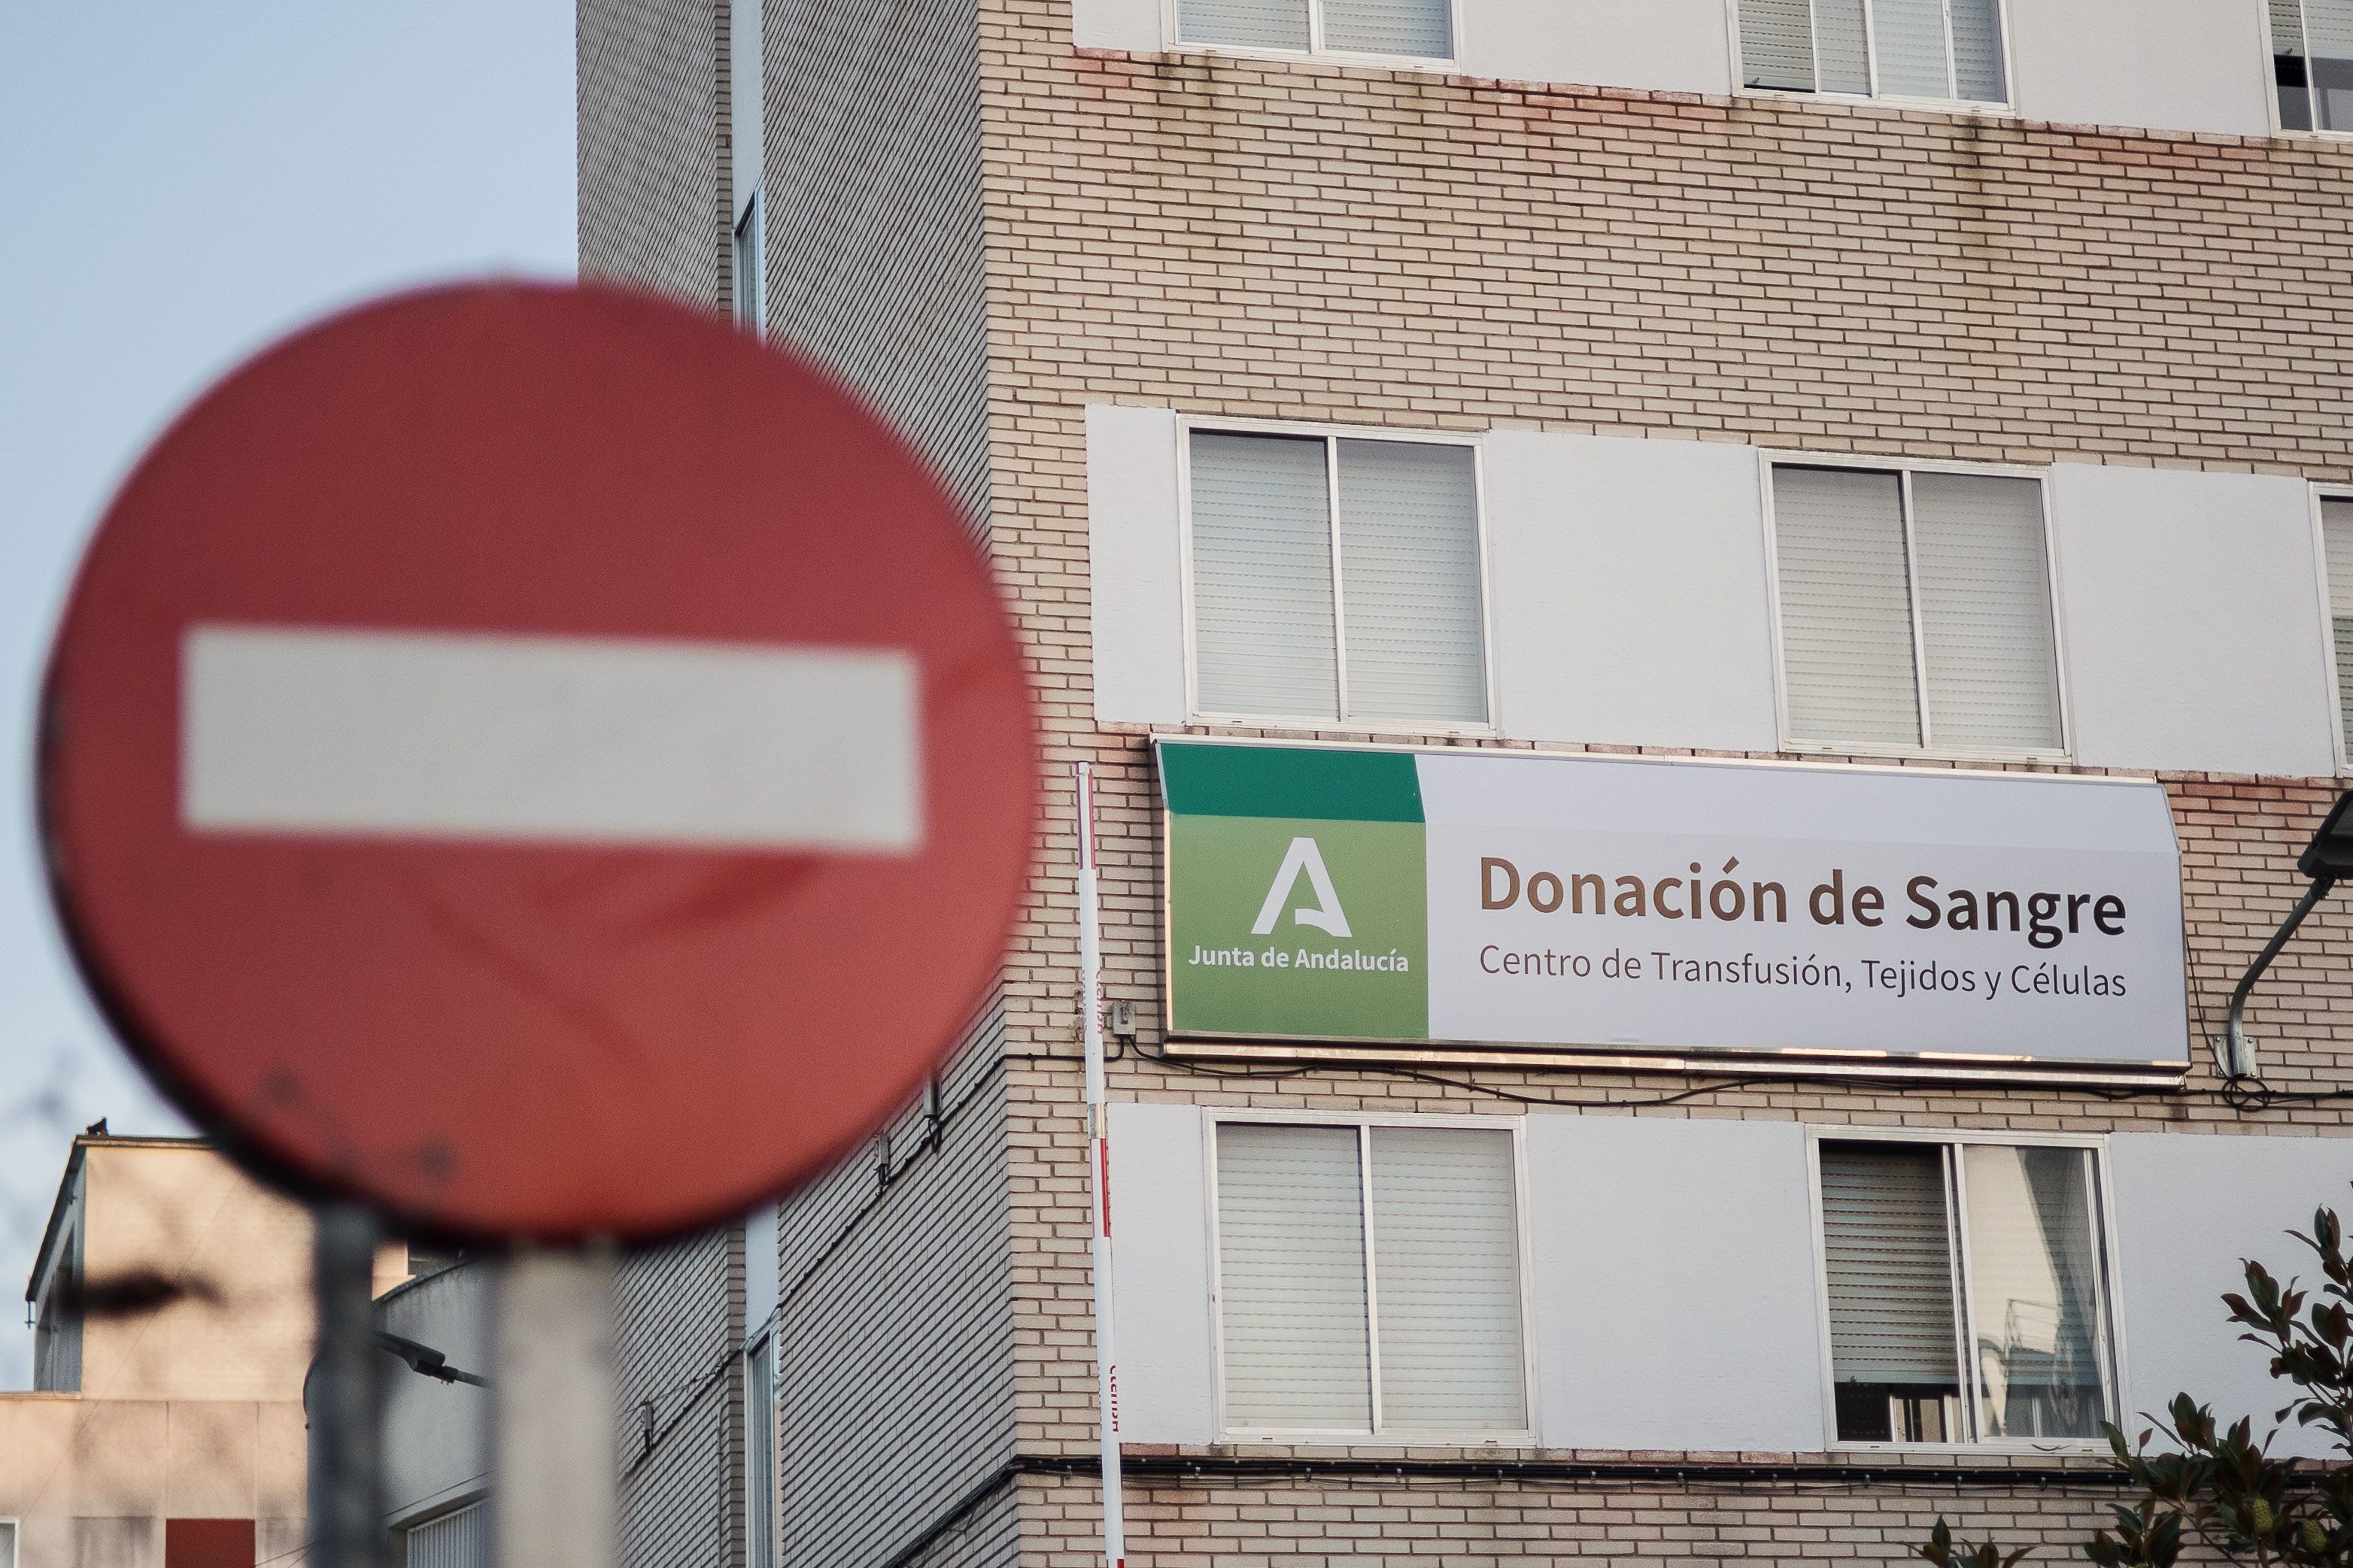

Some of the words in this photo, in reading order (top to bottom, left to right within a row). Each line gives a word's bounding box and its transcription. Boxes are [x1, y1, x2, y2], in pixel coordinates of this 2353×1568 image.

[1480, 856, 1788, 923] Donación
[1808, 869, 1885, 927] de
[1905, 875, 2127, 949] Sangre
[1189, 945, 1255, 967] Junta
[1261, 945, 1289, 968] de
[1295, 948, 1409, 972] Andalucía
[1480, 945, 1592, 978] Centro
[1602, 948, 1641, 978] de
[1650, 951, 1852, 993] Transfusión,
[1860, 959, 1976, 998] Tejidos
[1984, 970, 2002, 1000] y
[2011, 961, 2127, 997] Células
